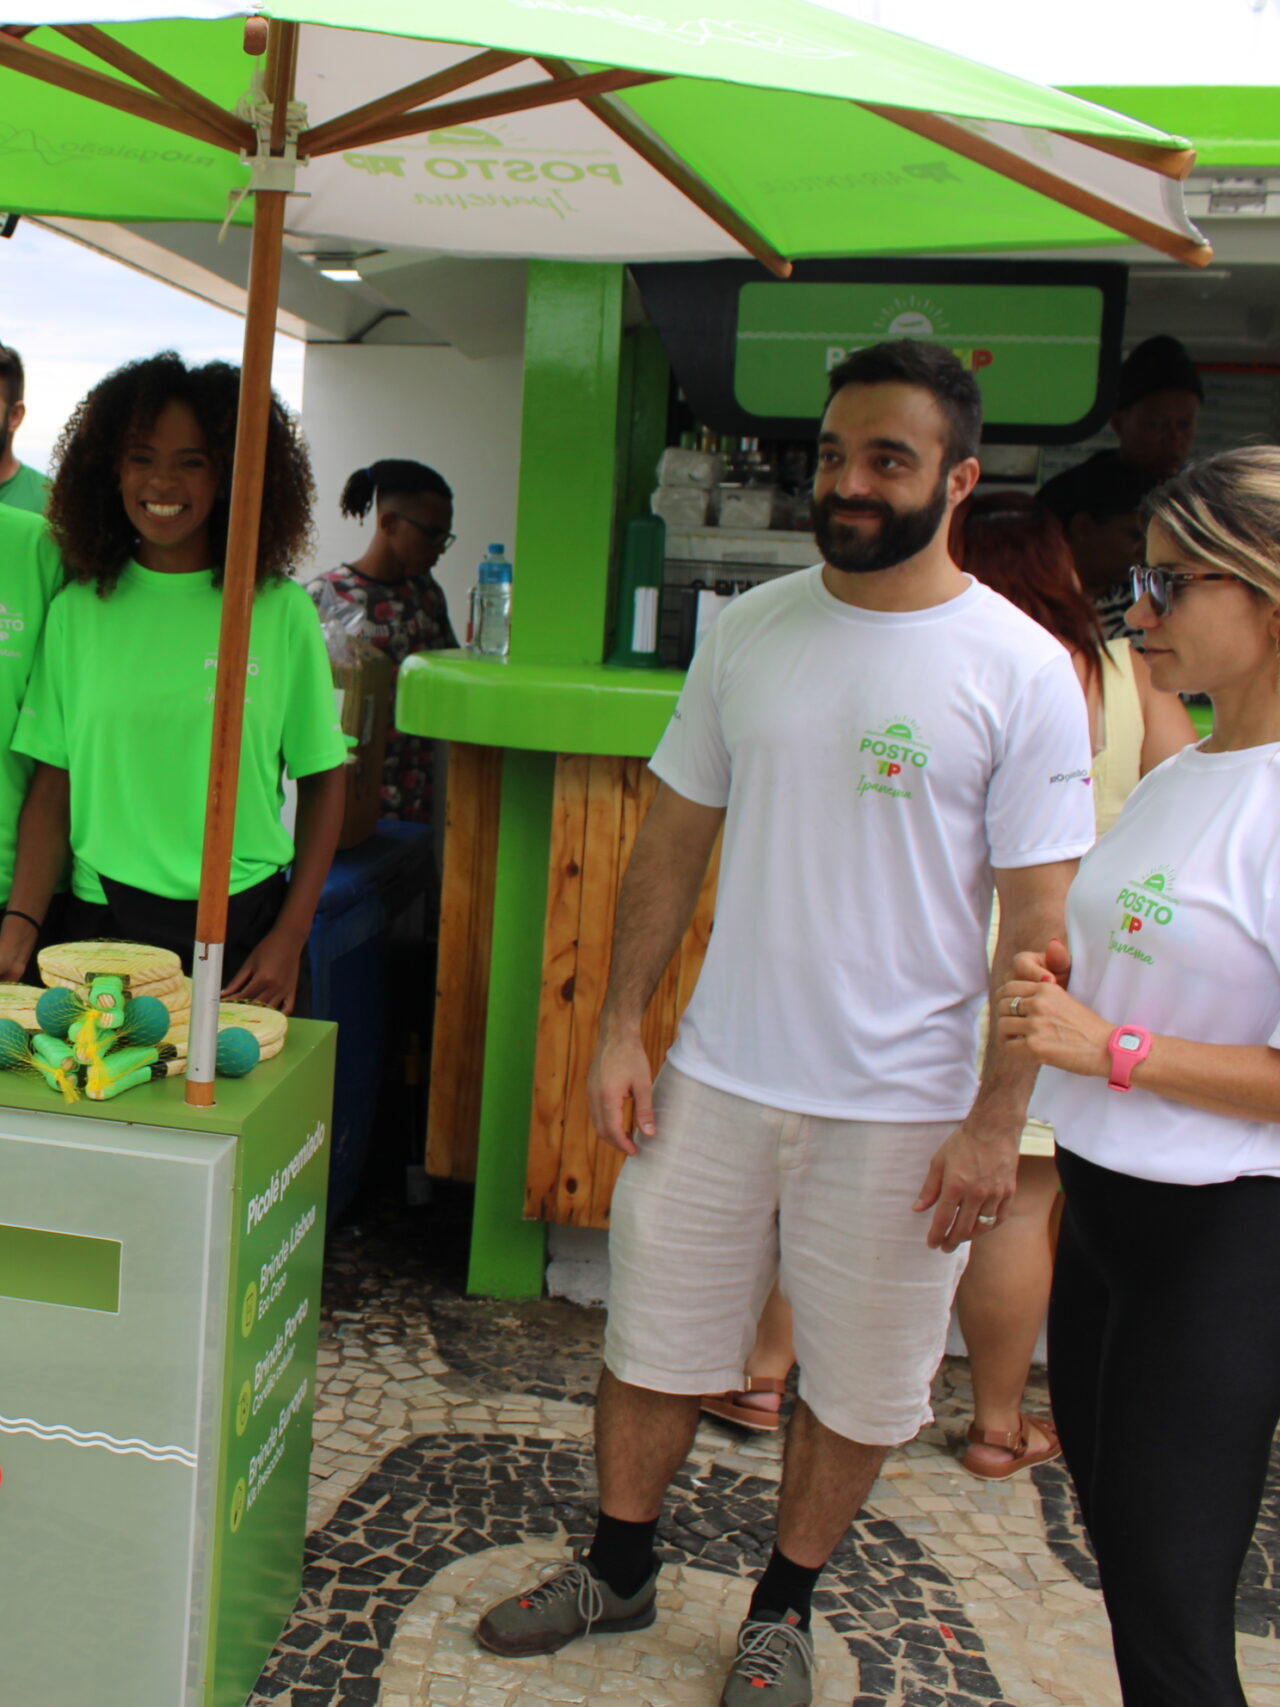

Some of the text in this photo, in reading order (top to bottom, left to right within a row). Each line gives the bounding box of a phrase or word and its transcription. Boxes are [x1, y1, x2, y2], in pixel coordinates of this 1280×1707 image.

[859, 738, 929, 768] POSTO
[1116, 888, 1173, 926] POSTO
[247, 1120, 325, 1235] Picolé premiado
[260, 1239, 290, 1294] Brinde
[254, 1333, 284, 1391] Brinde
